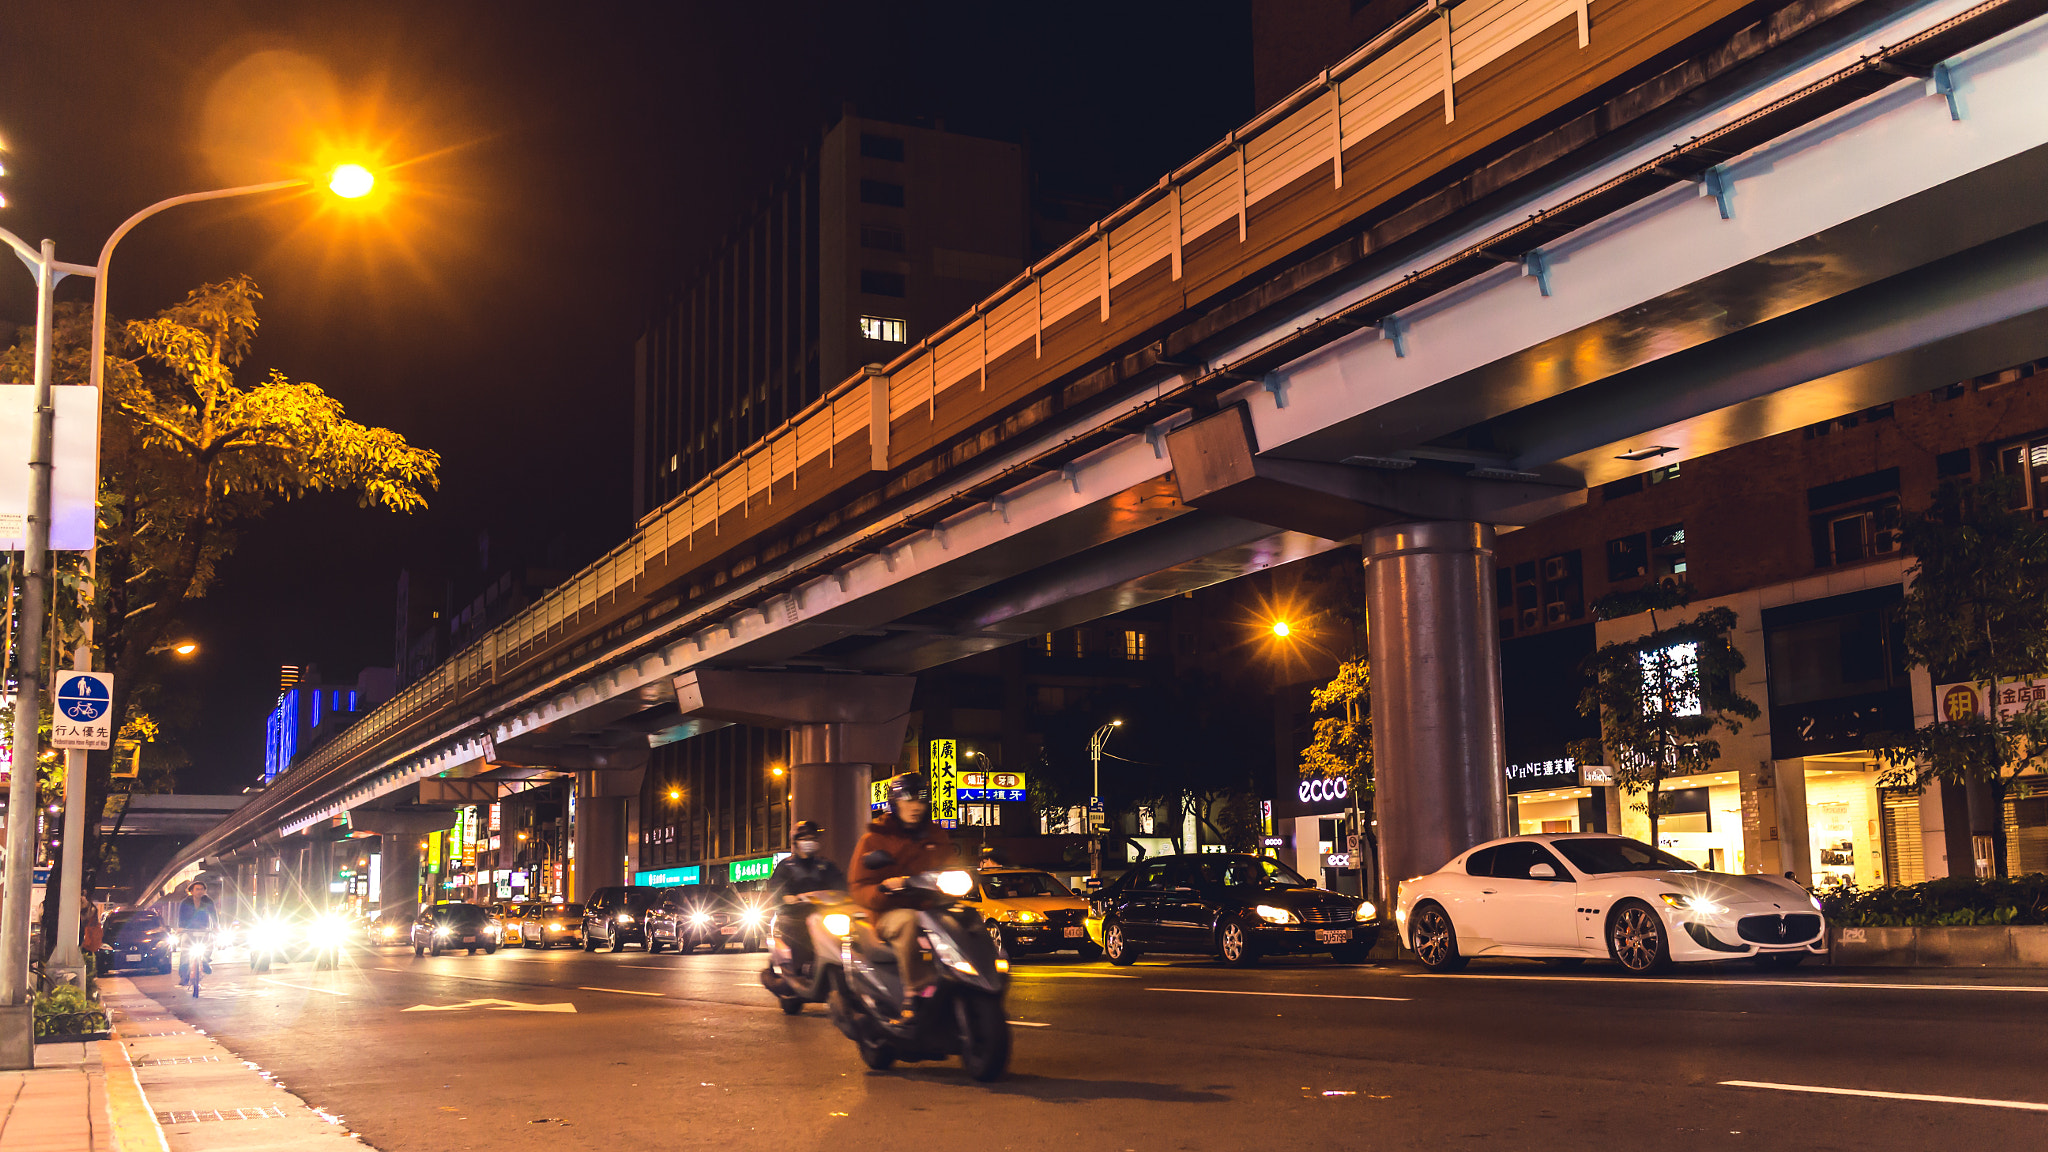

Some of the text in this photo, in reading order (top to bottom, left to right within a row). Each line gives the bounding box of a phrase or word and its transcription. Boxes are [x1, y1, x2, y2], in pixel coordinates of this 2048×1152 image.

[1990, 684, 2046, 706] 金店面
[1948, 691, 1973, 721] 租
[55, 725, 109, 738] 行人優先
[1505, 762, 1541, 779] APHNE
[1543, 757, 1576, 776] 達芙妮
[941, 741, 956, 818] 廣大牙醫
[960, 790, 1023, 801] 人工植牙
[1299, 776, 1347, 802] ecco
[1090, 797, 1099, 807] P
[1327, 854, 1350, 866] ecc
